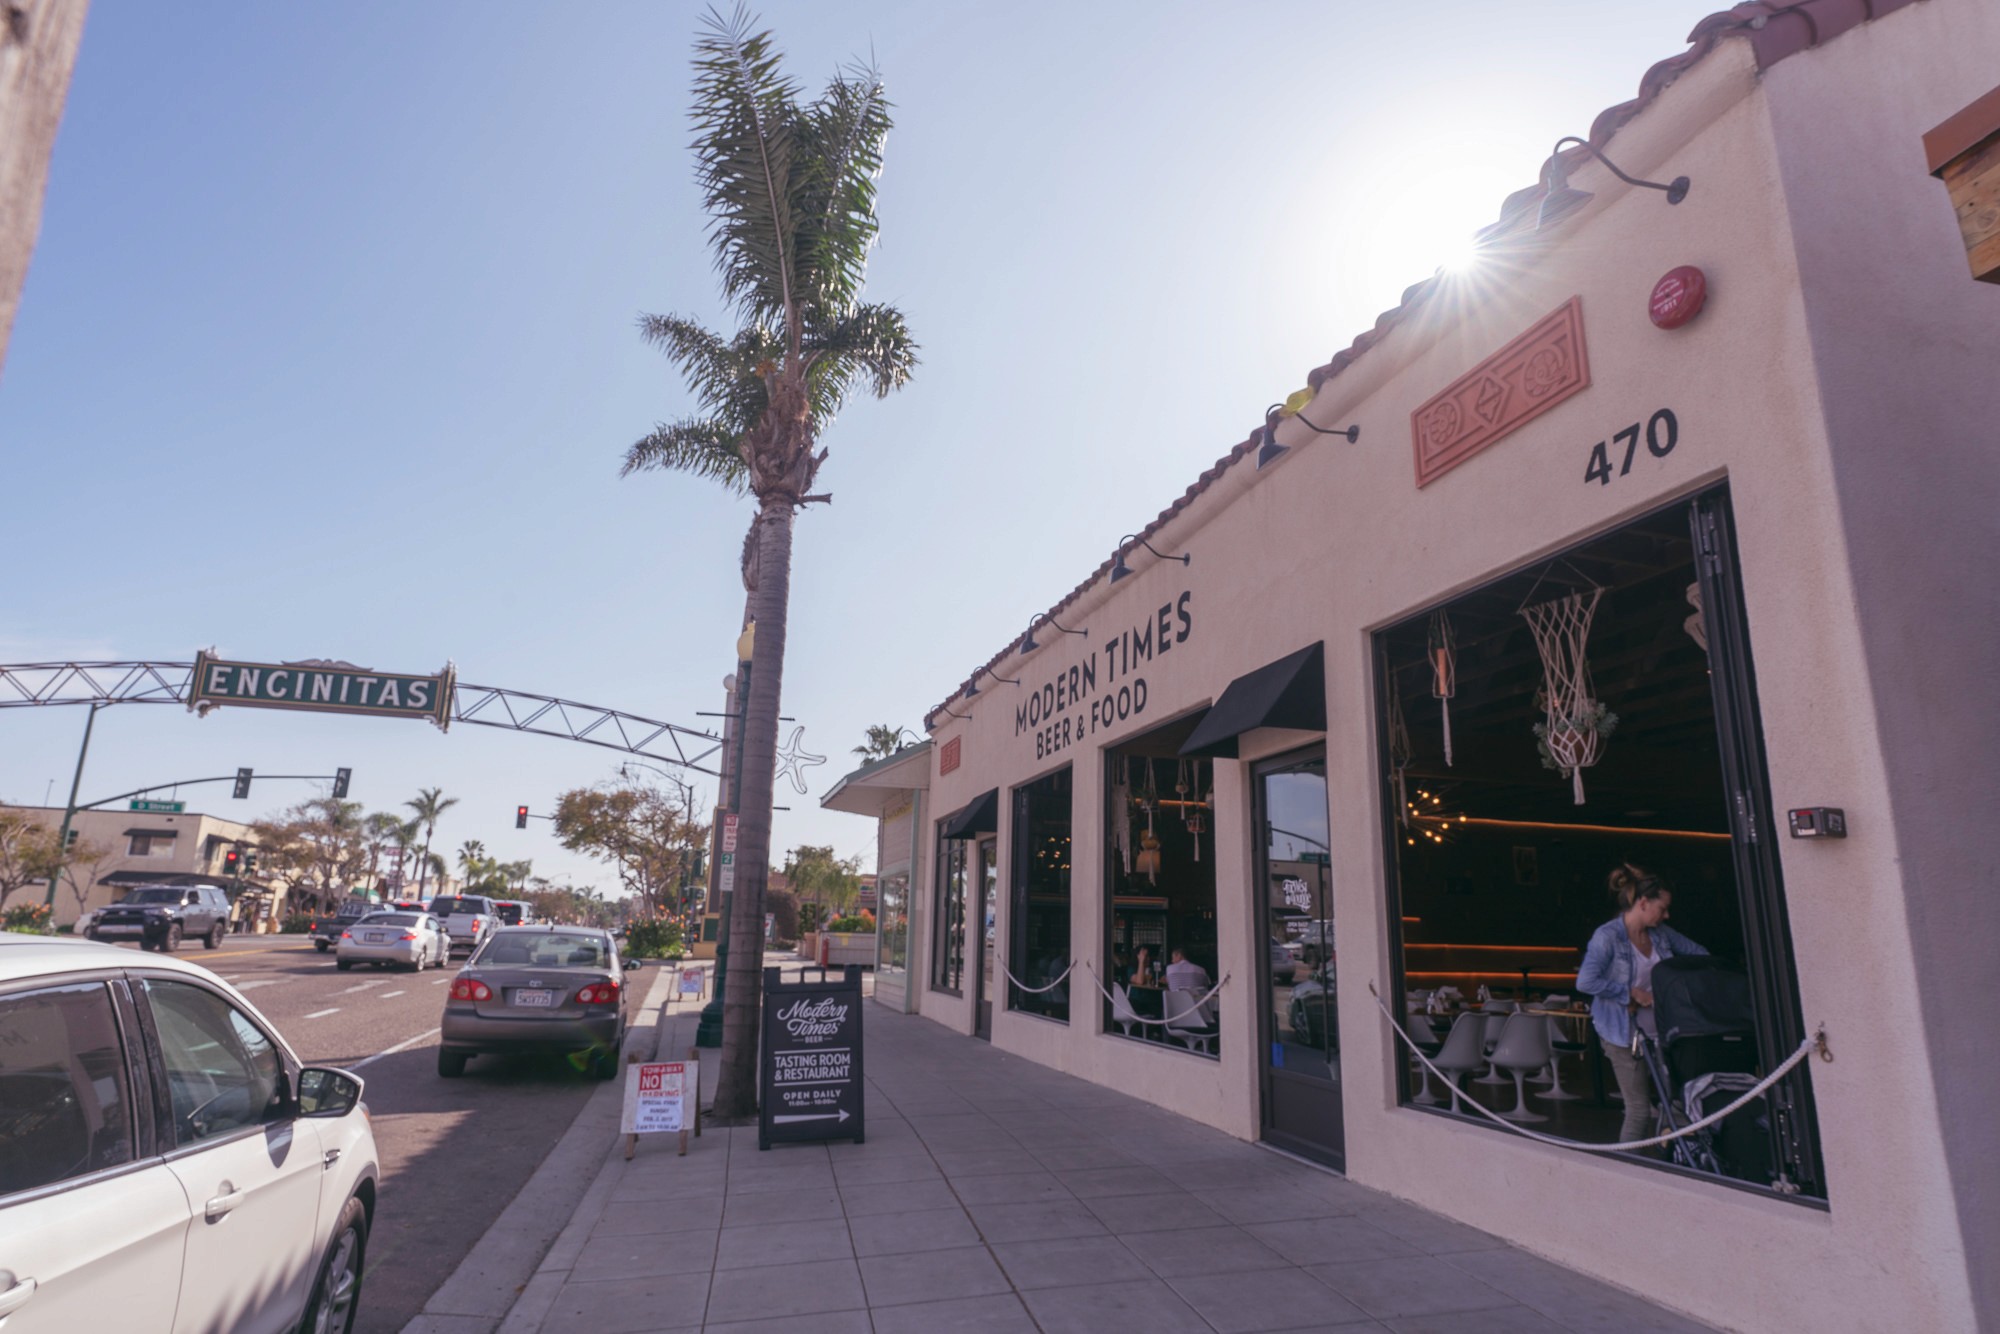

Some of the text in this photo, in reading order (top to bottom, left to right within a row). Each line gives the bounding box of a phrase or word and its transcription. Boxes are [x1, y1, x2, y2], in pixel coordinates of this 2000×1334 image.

[1584, 407, 1679, 487] 470
[1015, 590, 1192, 737] MODERN TIMES
[208, 665, 430, 708] ENCINITAS
[1037, 678, 1148, 760] BEER & FOOD
[149, 802, 175, 811] Street
[777, 997, 848, 1022] Modern
[786, 1018, 839, 1036] Times
[774, 1053, 851, 1068] TASTING ROOM
[774, 1065, 850, 1081] & RESTAURANT
[641, 1075, 660, 1089] NO
[642, 1089, 680, 1097] PARKING
[783, 1089, 842, 1101] OPEN DAILY
